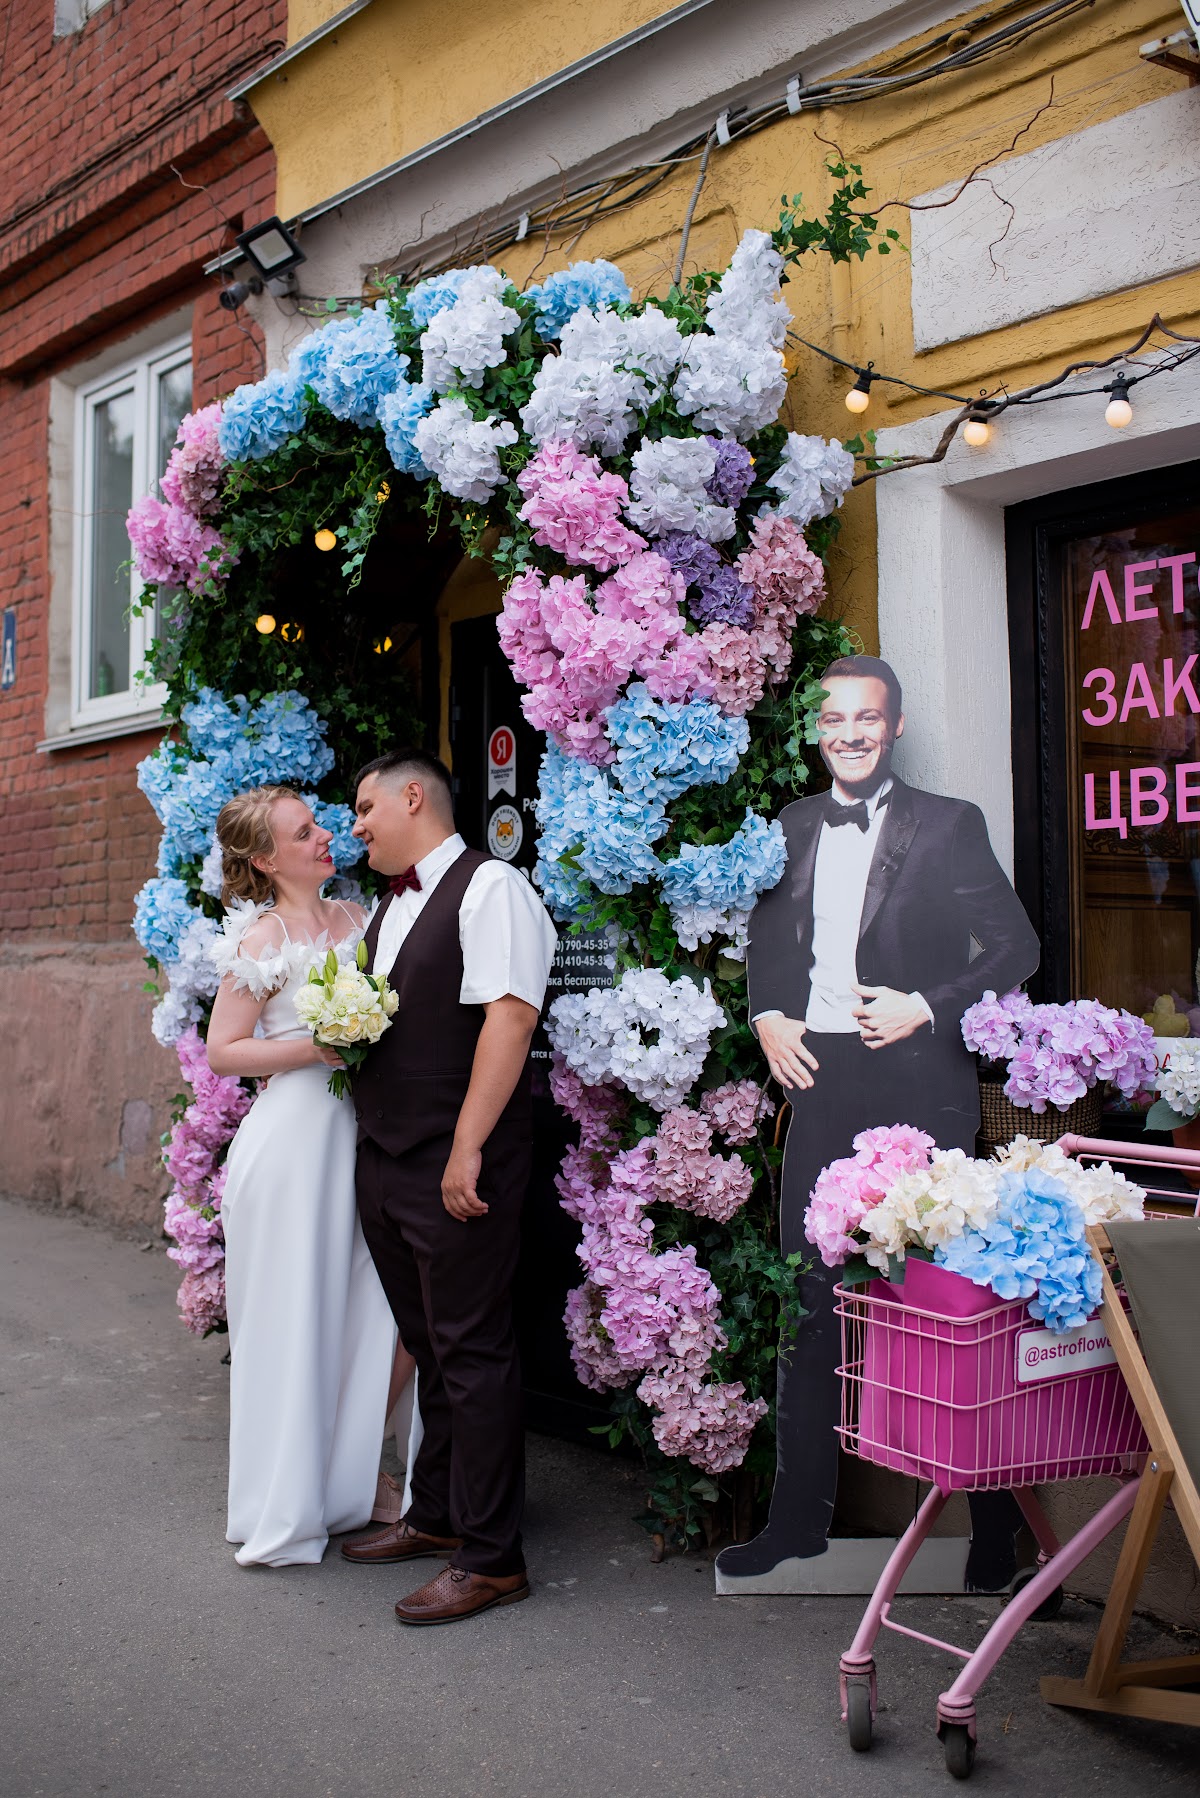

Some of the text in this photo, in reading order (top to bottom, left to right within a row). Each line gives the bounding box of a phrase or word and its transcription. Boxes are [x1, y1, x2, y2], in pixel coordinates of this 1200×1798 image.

[1081, 552, 1200, 630] ЛЕТ
[497, 736, 506, 760] Я
[565, 939, 609, 950] 790-45-35
[565, 955, 606, 967] 410-45-3
[564, 973, 613, 986] бесплатно
